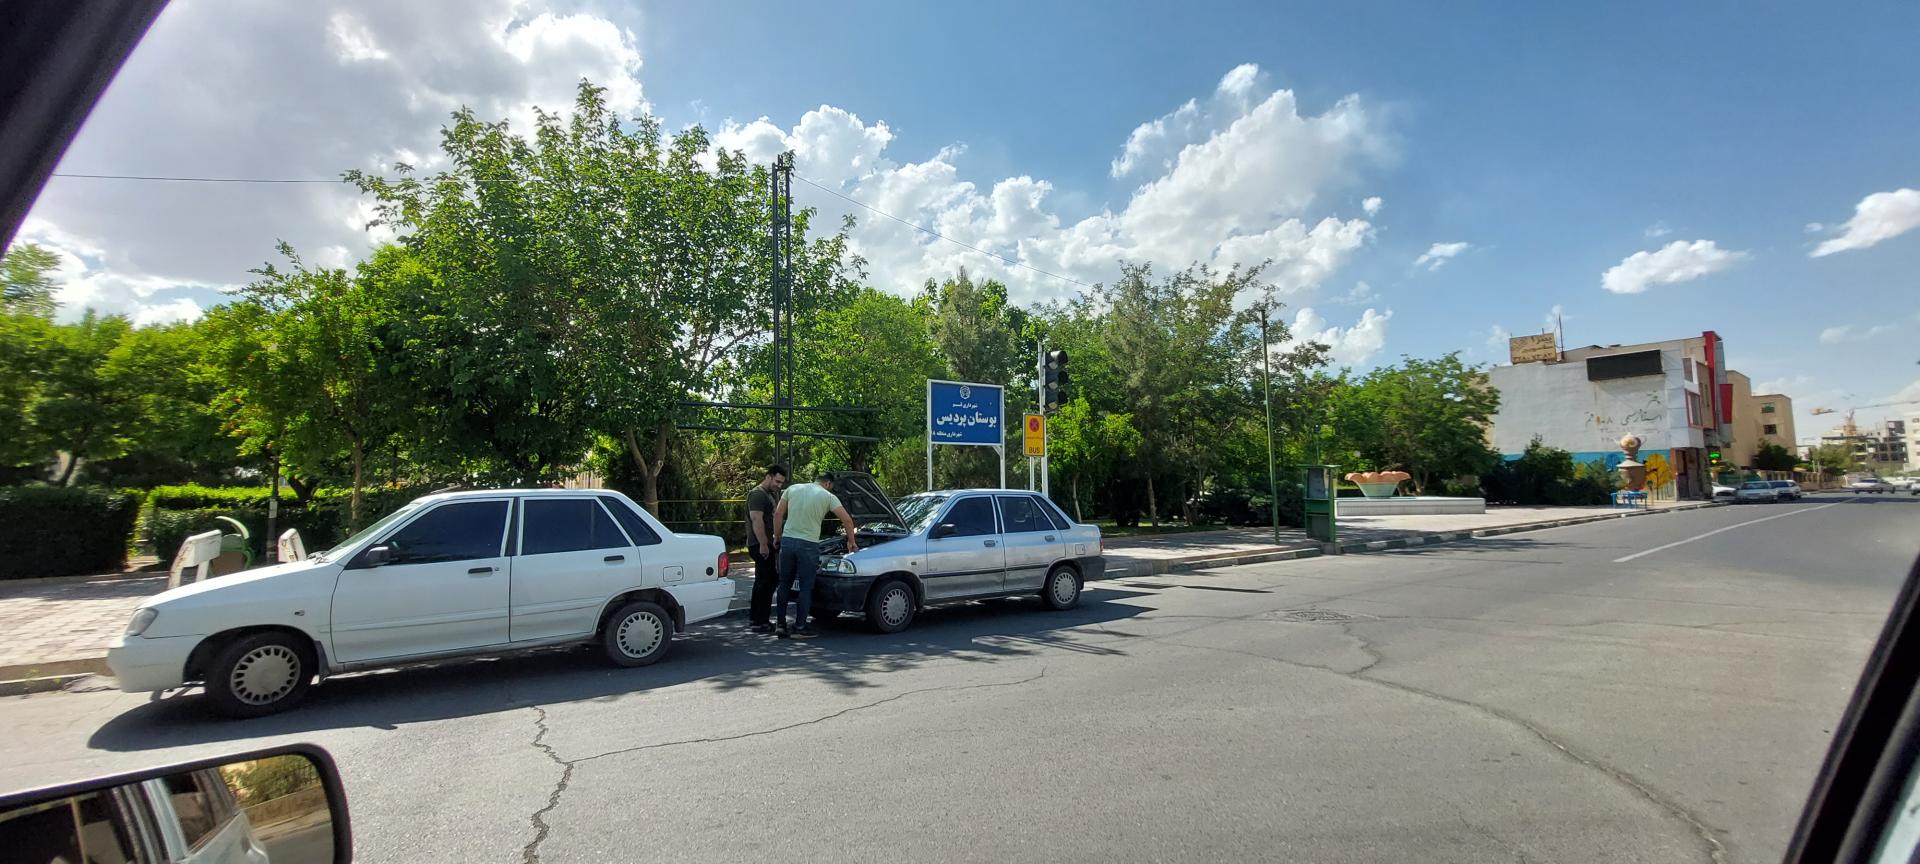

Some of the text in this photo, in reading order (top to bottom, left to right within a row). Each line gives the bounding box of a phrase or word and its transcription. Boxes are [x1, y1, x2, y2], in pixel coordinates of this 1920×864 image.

[936, 411, 997, 428] بوستان پردیس
[1028, 446, 1041, 454] BUS
